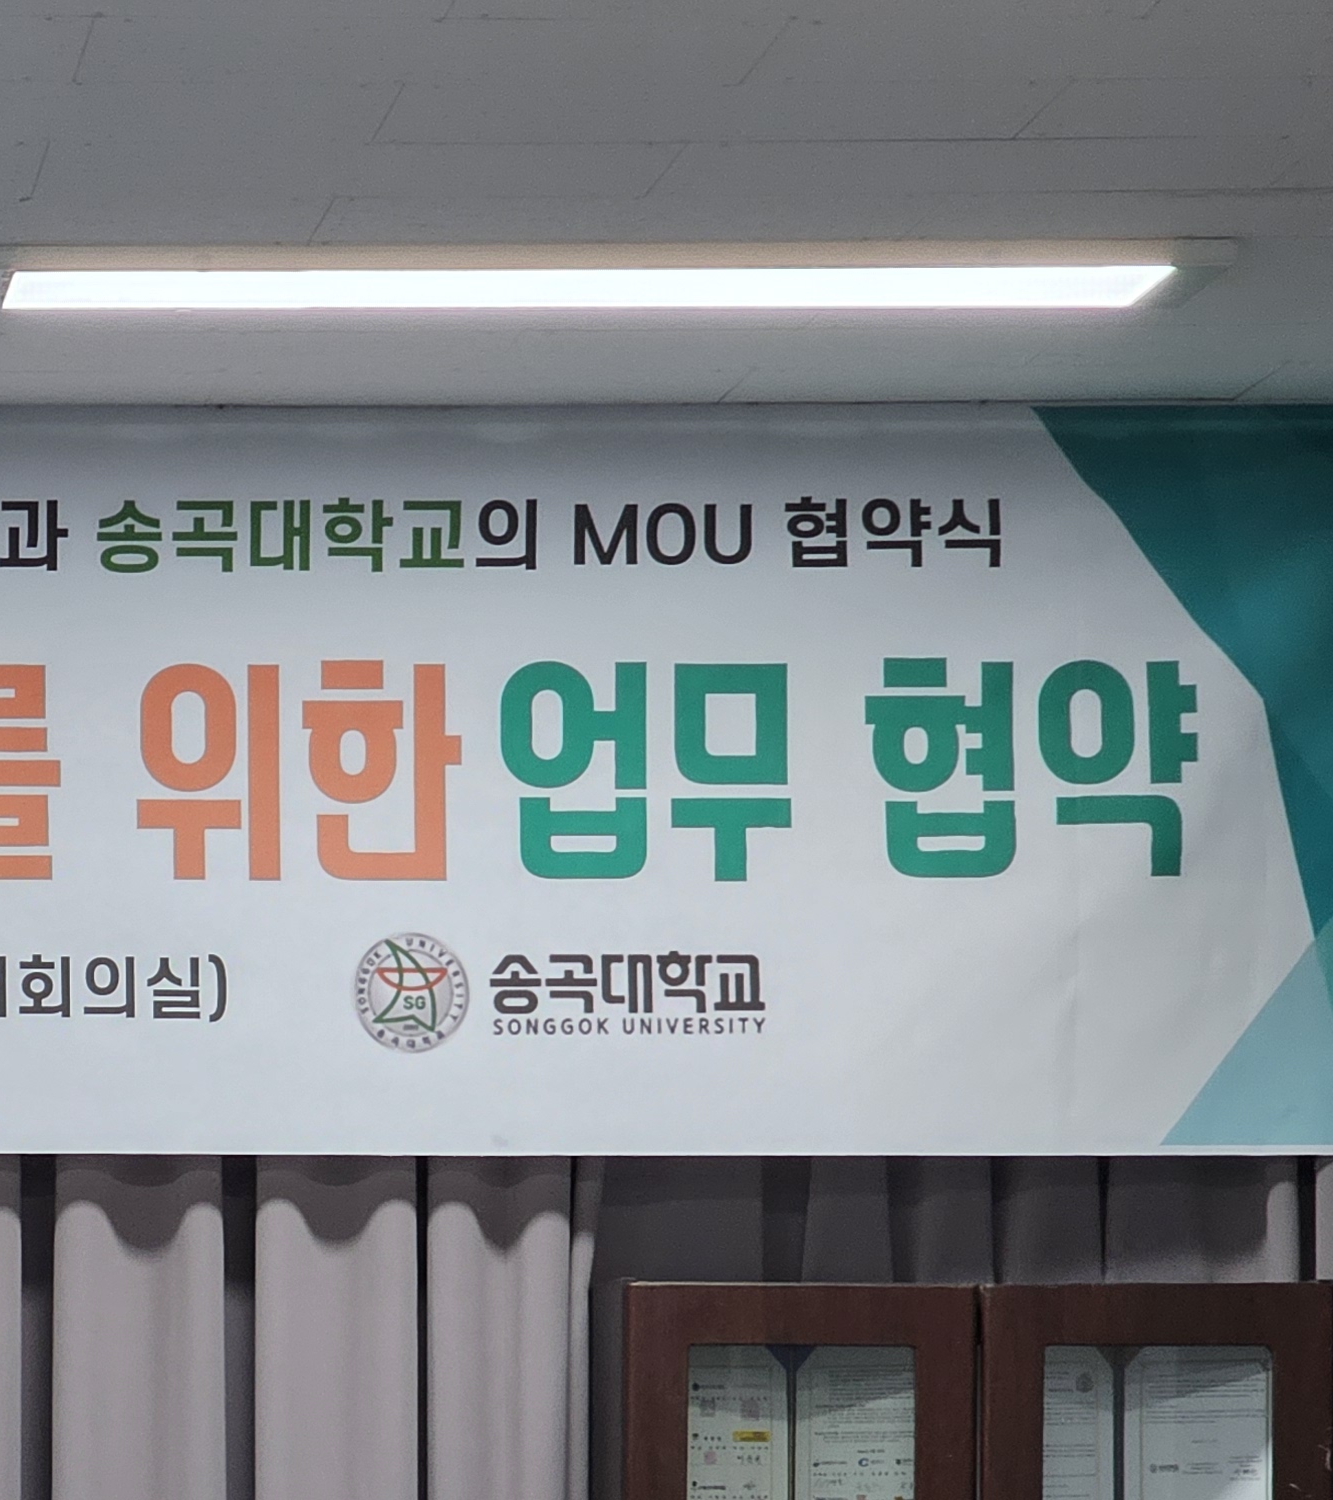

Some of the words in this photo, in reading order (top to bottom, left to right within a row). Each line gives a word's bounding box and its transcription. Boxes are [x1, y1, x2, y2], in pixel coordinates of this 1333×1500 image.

[98, 499, 538, 573] 송곡대학교의
[575, 504, 753, 566] MOU
[786, 497, 1001, 568] 협약식
[138, 659, 461, 880] 위한
[500, 662, 792, 882] 업무
[865, 656, 1199, 879] 협약
[402, 995, 427, 1011] SG
[490, 951, 767, 1015] 송곡대학교
[493, 1018, 611, 1036] SONGGOK
[623, 1017, 767, 1035] UNIVERSITY
